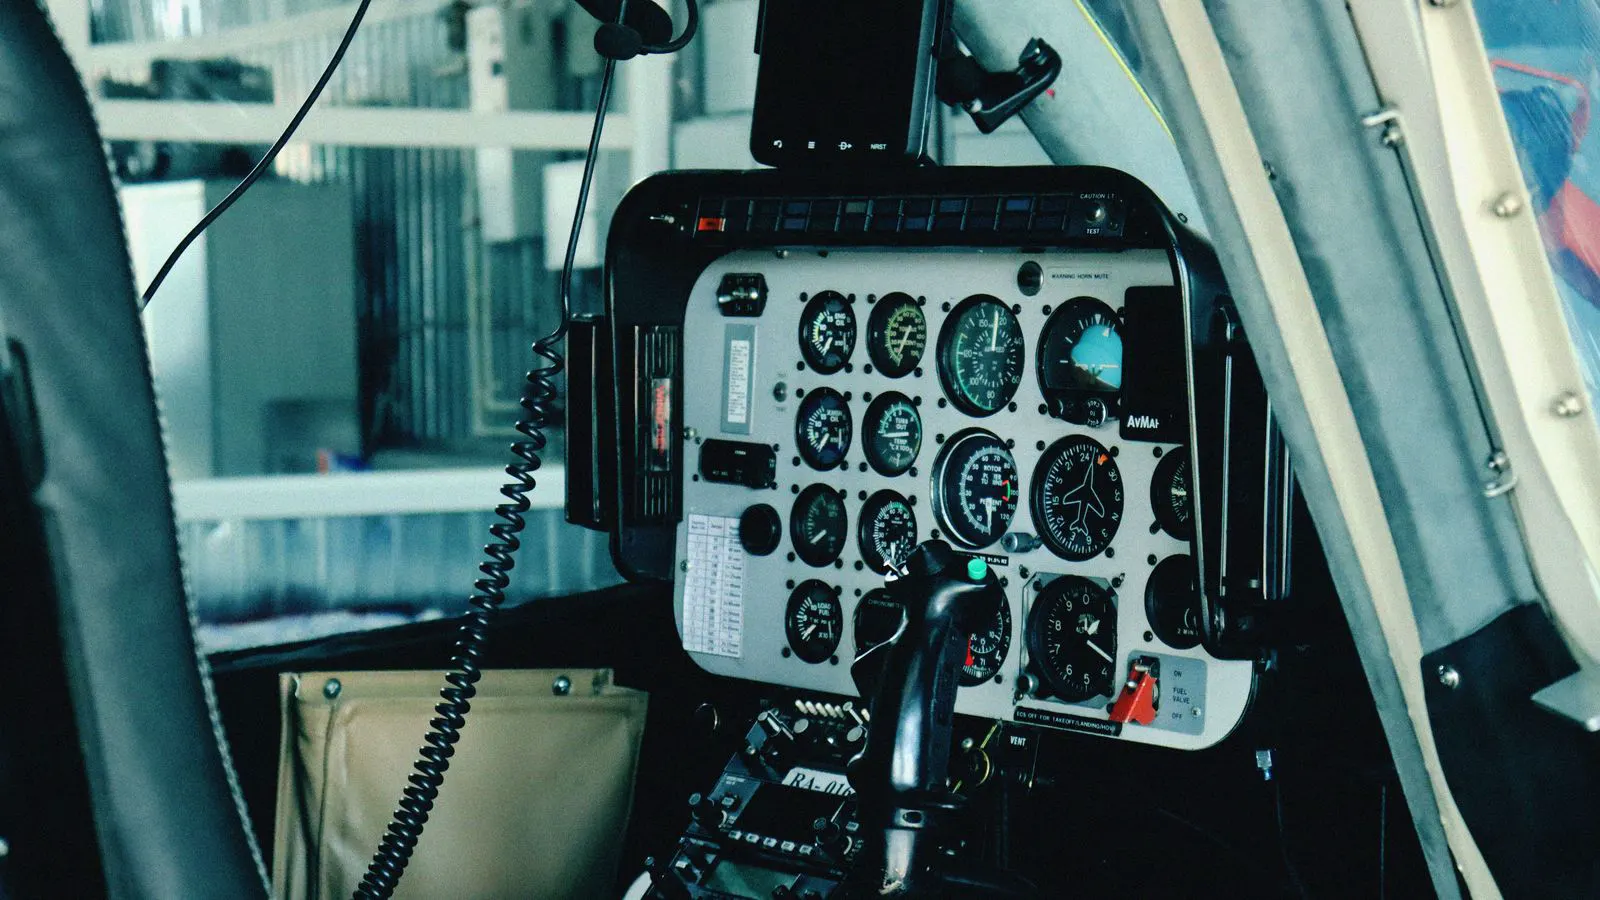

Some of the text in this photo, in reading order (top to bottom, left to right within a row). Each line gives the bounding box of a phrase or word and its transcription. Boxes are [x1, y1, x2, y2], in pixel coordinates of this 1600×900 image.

[987, 391, 995, 399] 80
[1080, 453, 1090, 462] 24
[1064, 460, 1074, 471] 21
[1108, 468, 1118, 482] 30
[1052, 496, 1059, 505] 15
[1114, 489, 1120, 502] 33
[1057, 515, 1064, 527] 12
[1082, 594, 1090, 605] 0
[817, 602, 831, 610] LOAD
[1066, 600, 1073, 611] 9
[1055, 620, 1062, 631] 8
[1055, 643, 1060, 655] 7
[1066, 664, 1073, 676] 6
[1101, 667, 1108, 676] 4
[1084, 673, 1090, 685] 5
[1173, 687, 1188, 696] FUEL
[1172, 695, 1190, 704] VALVE
[1010, 735, 1026, 747] VENT
